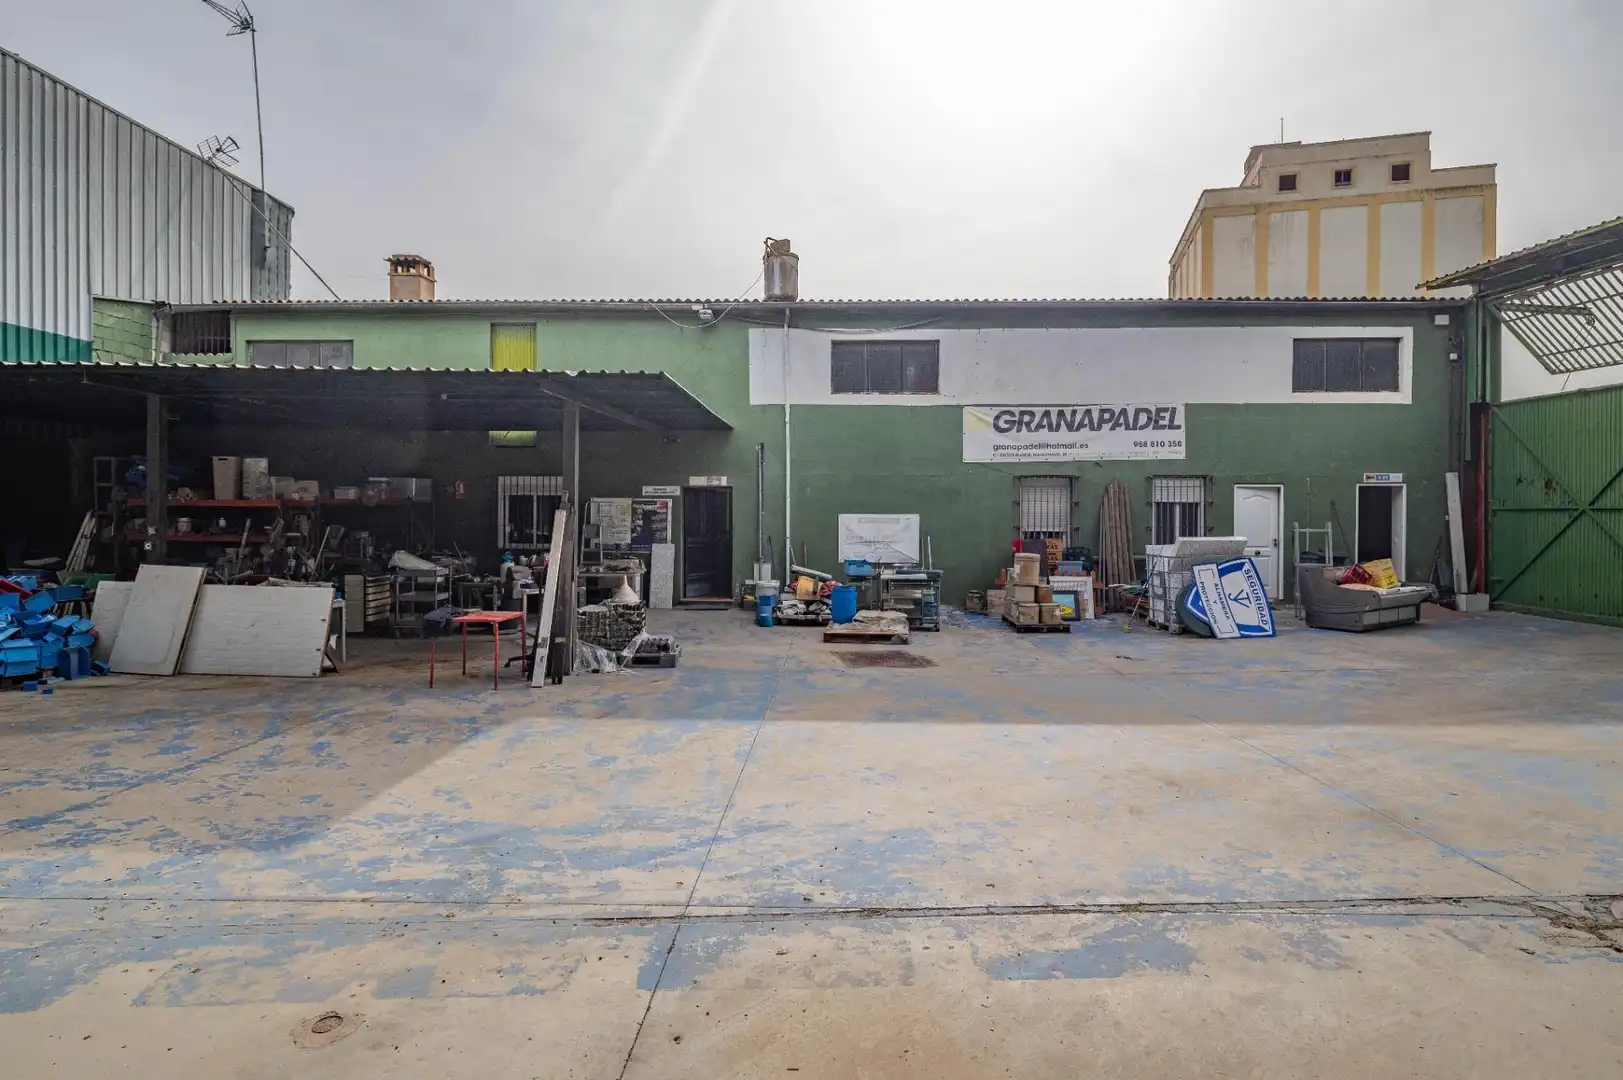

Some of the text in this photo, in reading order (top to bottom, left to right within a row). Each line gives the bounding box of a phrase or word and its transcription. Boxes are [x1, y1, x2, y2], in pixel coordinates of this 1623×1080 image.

[993, 407, 1182, 433] GRANAPADEL
[1150, 440, 1165, 448] 810
[1244, 568, 1268, 626] SEGURIDAD
